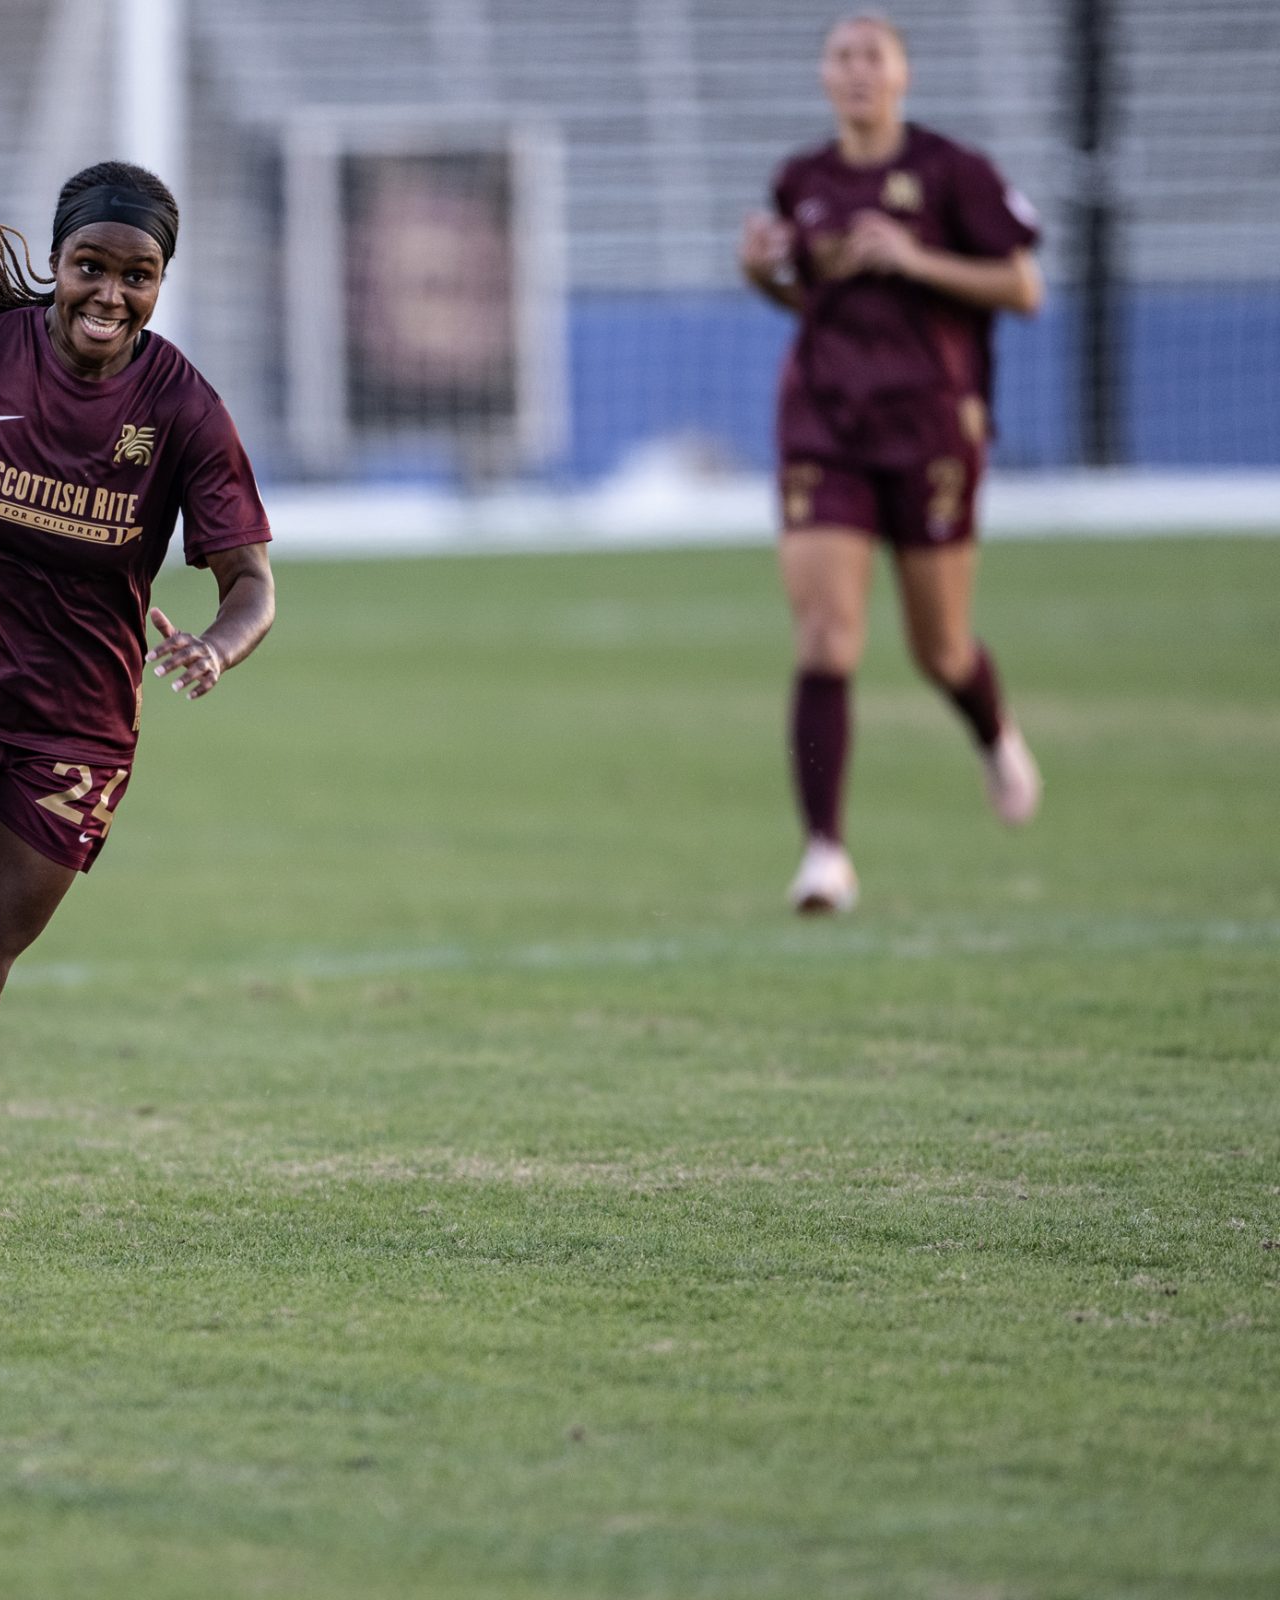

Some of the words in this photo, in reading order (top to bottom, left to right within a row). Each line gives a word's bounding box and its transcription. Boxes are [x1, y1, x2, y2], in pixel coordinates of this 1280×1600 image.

[3, 507, 28, 520] FOR
[33, 515, 102, 537] CHILDREN
[91, 487, 139, 524] RITE
